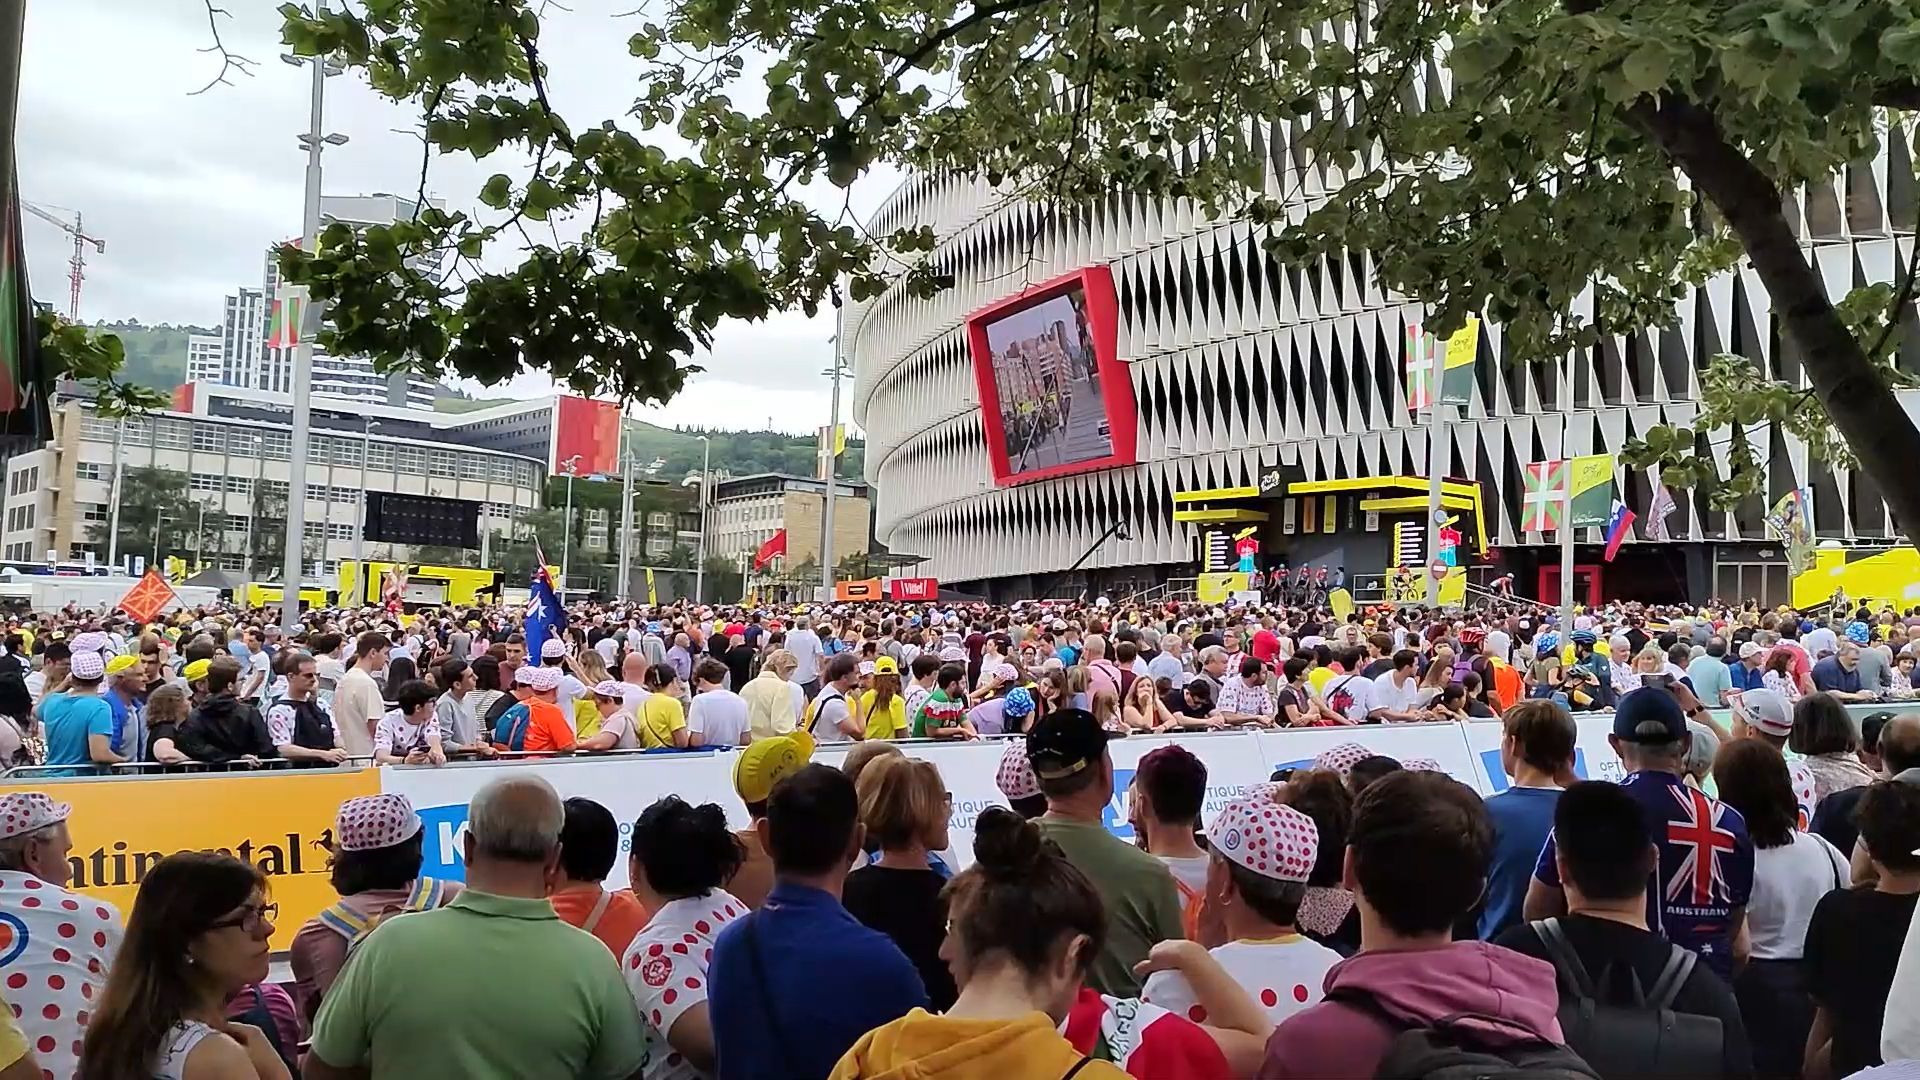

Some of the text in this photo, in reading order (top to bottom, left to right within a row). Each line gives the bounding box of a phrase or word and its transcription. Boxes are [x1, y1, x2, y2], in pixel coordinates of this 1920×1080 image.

[1600, 761, 1622, 771] OPT
[1206, 785, 1245, 798] TIQUE
[951, 800, 994, 814] TIQU
[66, 833, 304, 890] ntintal
